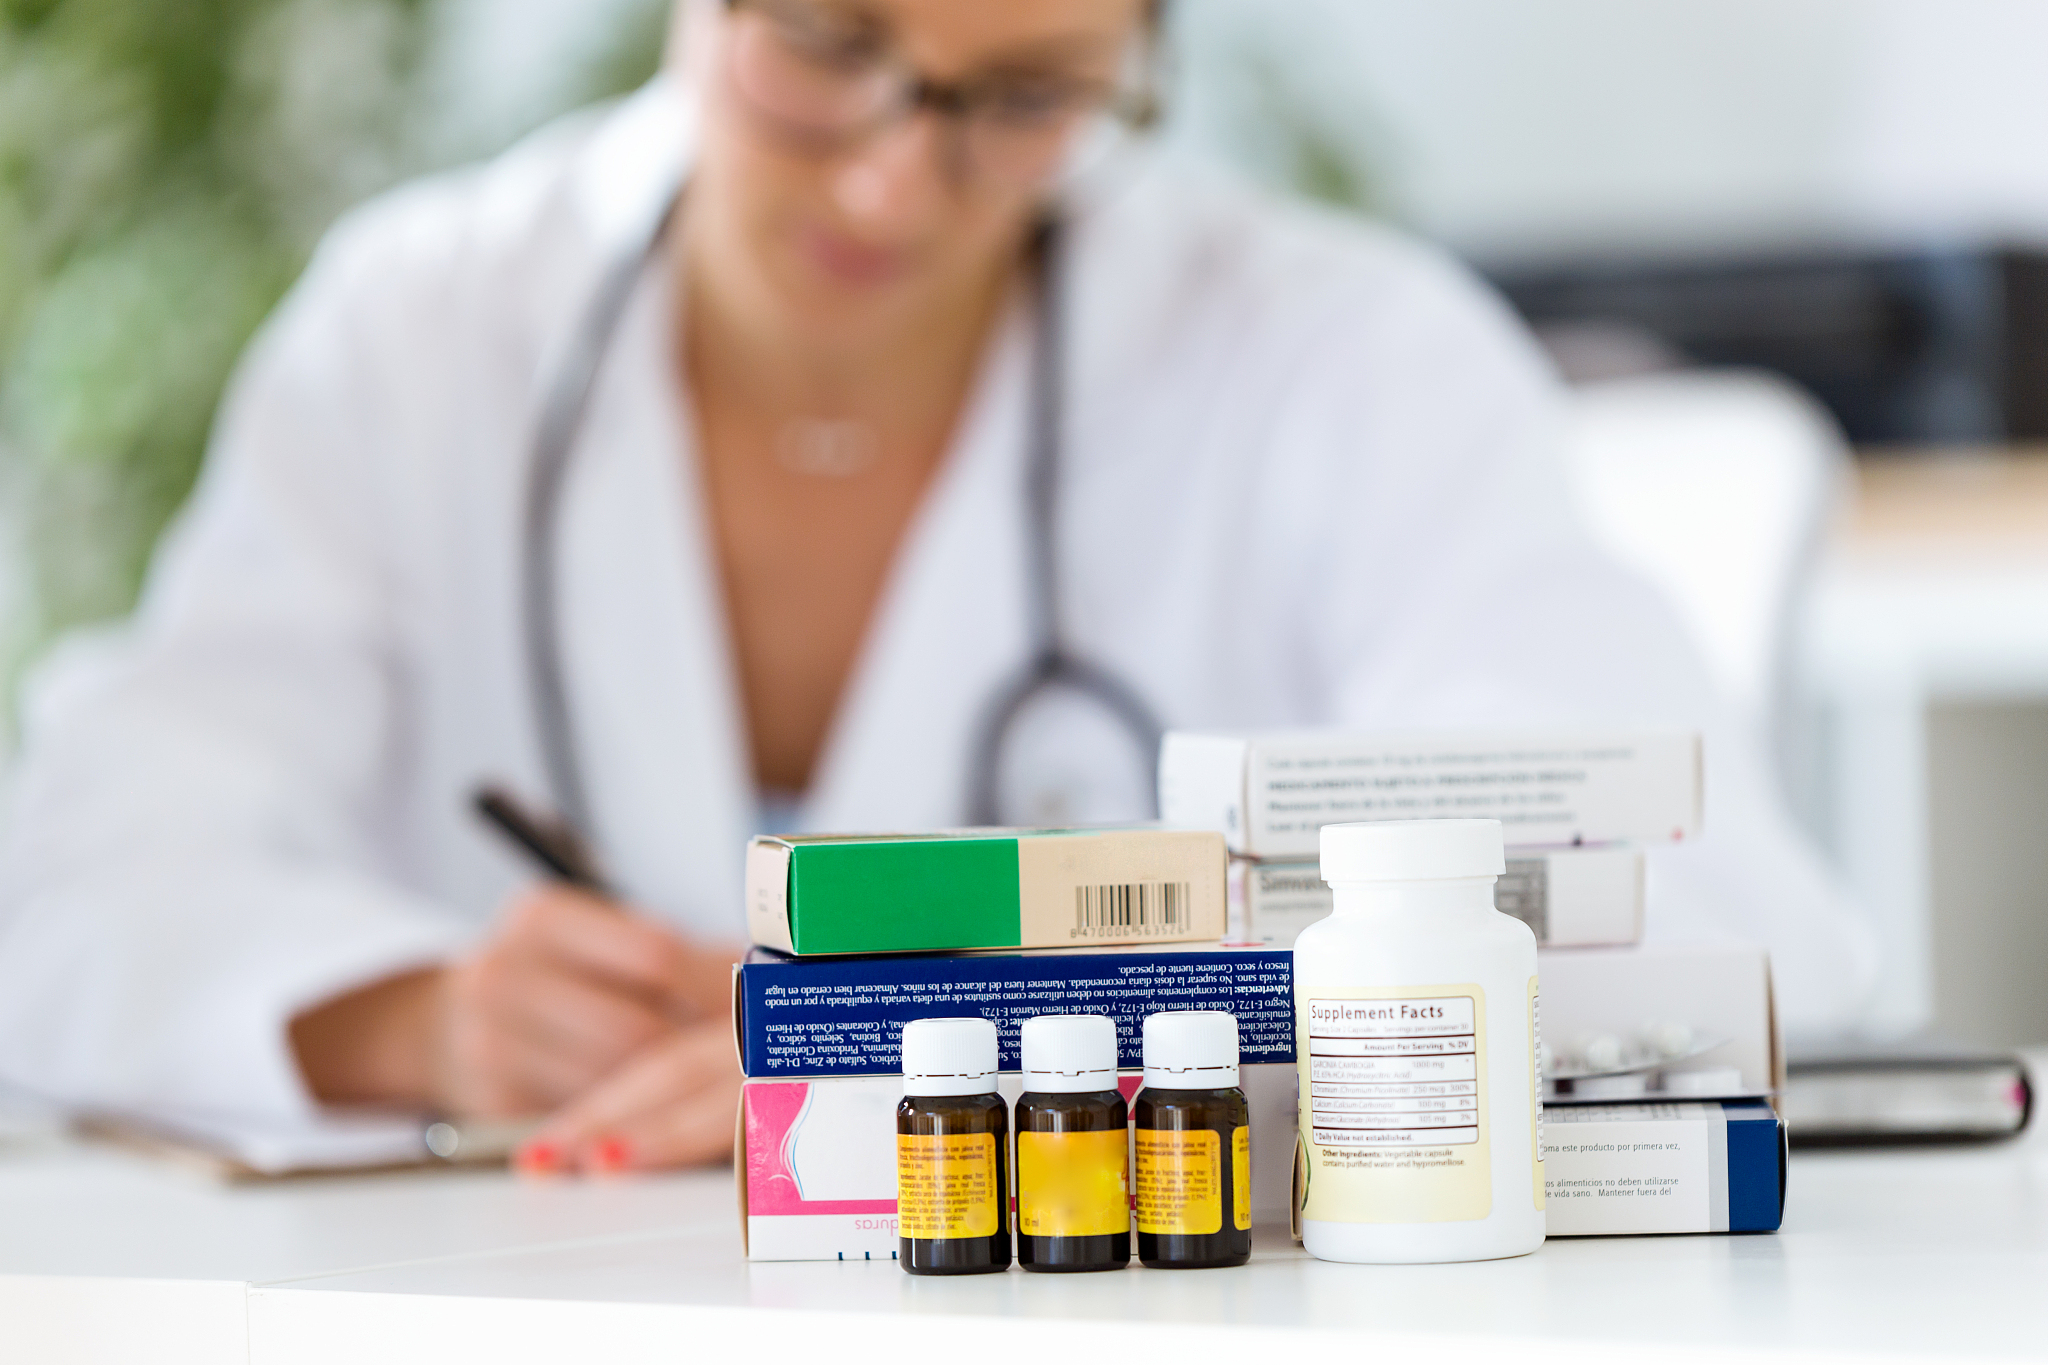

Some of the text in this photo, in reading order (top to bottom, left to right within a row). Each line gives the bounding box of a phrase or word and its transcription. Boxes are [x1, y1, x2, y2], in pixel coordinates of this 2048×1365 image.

[1119, 963, 1154, 976] pescado.
[1169, 964, 1194, 974] fuente
[1196, 963, 1233, 974] Contiene
[1258, 960, 1263, 969] y
[1265, 962, 1290, 972] fresco
[1156, 965, 1167, 975] de
[1129, 977, 1152, 987] diaria
[1154, 977, 1175, 986] dosis
[1178, 976, 1185, 986] la
[1188, 973, 1218, 983] superar
[1220, 975, 1233, 985] No
[1236, 974, 1257, 982] sano.
[1260, 974, 1277, 984] vida
[1279, 974, 1290, 983] de
[901, 983, 926, 993] niños.
[928, 983, 940, 992] los
[942, 982, 953, 992] de
[955, 981, 987, 992] alcance
[989, 981, 1002, 991] del
[1005, 980, 1025, 990] fuera
[1027, 979, 1066, 990] Mantener
[1069, 978, 1126, 989] recomendada.
[765, 984, 786, 997] lugar
[801, 986, 832, 996] cerrado
[835, 985, 853, 995] bien
[855, 984, 899, 994] Almacenar
[1107, 988, 1156, 999] alimenticios
[1158, 984, 1217, 997] complementos
[1219, 986, 1233, 996] Los
[1235, 985, 1290, 995] Advertencias:
[804, 995, 818, 1005] por
[820, 995, 825, 1004] y
[875, 993, 880, 1003] y
[882, 995, 911, 1005] variada
[913, 994, 933, 1004] dieta
[952, 994, 963, 1003] de
[964, 992, 1002, 1003] sustitutos
[1028, 991, 1065, 1001] utilizarse
[1067, 990, 1092, 1000] deben
[765, 998, 790, 1008] modo
[827, 994, 873, 1007] equilibrada
[980, 997, 1290, 1017] Negro E-172, Óxido de Hierro Rojo E-172, y Óxido de Hierro Marrón E-172).
[1136, 1012, 1141, 1021] y
[1311, 1005, 1444, 1022] Supplement Facts
[794, 1023, 805, 1033] de
[806, 1021, 835, 1034] (Óxido
[836, 1021, 880, 1032] Colorantes
[882, 1019, 887, 1028] y
[1238, 1022, 1291, 1032] Colecalcifero
[766, 1024, 793, 1034] Hierro
[767, 1032, 772, 1041] y
[778, 1032, 807, 1044] sódico,
[812, 1033, 844, 1043] Selenito
[850, 1030, 881, 1042] Biotina,
[1251, 1031, 1292, 1043] tocoferilo,
[767, 1043, 816, 1056] Clorhidrato,
[818, 1044, 859, 1054] Piridoxina
[1239, 1041, 1292, 1055] Ingredientes:
[1412, 1042, 1444, 1051] Serving
[767, 1057, 800, 1067] D-L-alfa
[803, 1055, 824, 1066] Zinc,
[826, 1056, 837, 1066] de
[839, 1055, 867, 1065] Sulfato
[870, 1053, 902, 1065] córbico,
[1352, 1133, 1364, 1141] not
[1580, 1143, 1615, 1153] producto
[1617, 1145, 1630, 1153] por
[1633, 1142, 1663, 1153] primera
[1665, 1143, 1681, 1151] vez,
[1322, 1149, 1338, 1157] Other
[1384, 1150, 1422, 1159] Vegetable
[1424, 1149, 1453, 1159] capsule
[1346, 1159, 1372, 1169] purified
[1396, 1160, 1411, 1168] and
[1557, 1177, 1603, 1187] alimenticios
[1605, 1179, 1616, 1187] no
[1618, 1177, 1642, 1186] deben
[1644, 1177, 1679, 1186] utilizarse
[1554, 1188, 1570, 1198] vida
[1598, 1188, 1634, 1197] Mantener
[1637, 1187, 1657, 1196] fuera
[1659, 1187, 1672, 1196] del
